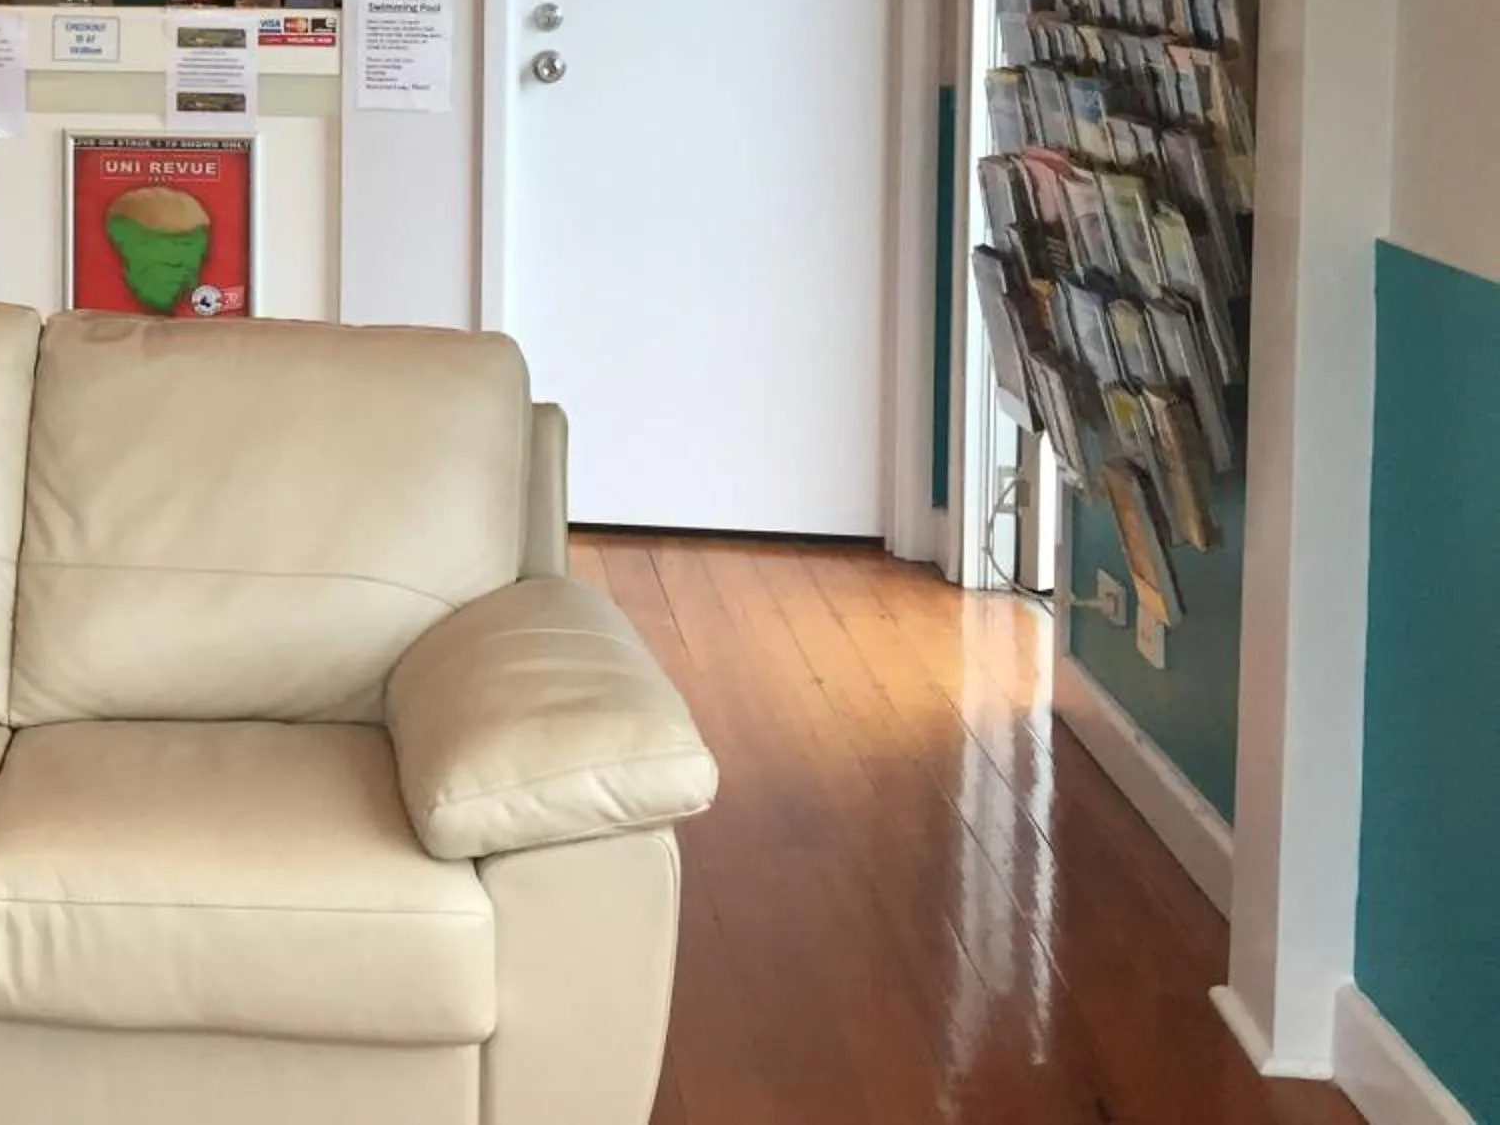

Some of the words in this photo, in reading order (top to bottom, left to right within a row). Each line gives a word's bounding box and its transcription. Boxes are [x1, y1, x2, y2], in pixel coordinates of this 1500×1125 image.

[368, 2, 418, 14] Swimming
[419, 2, 442, 13] Pool
[105, 160, 141, 174] UNI
[149, 161, 217, 175] REVUE
